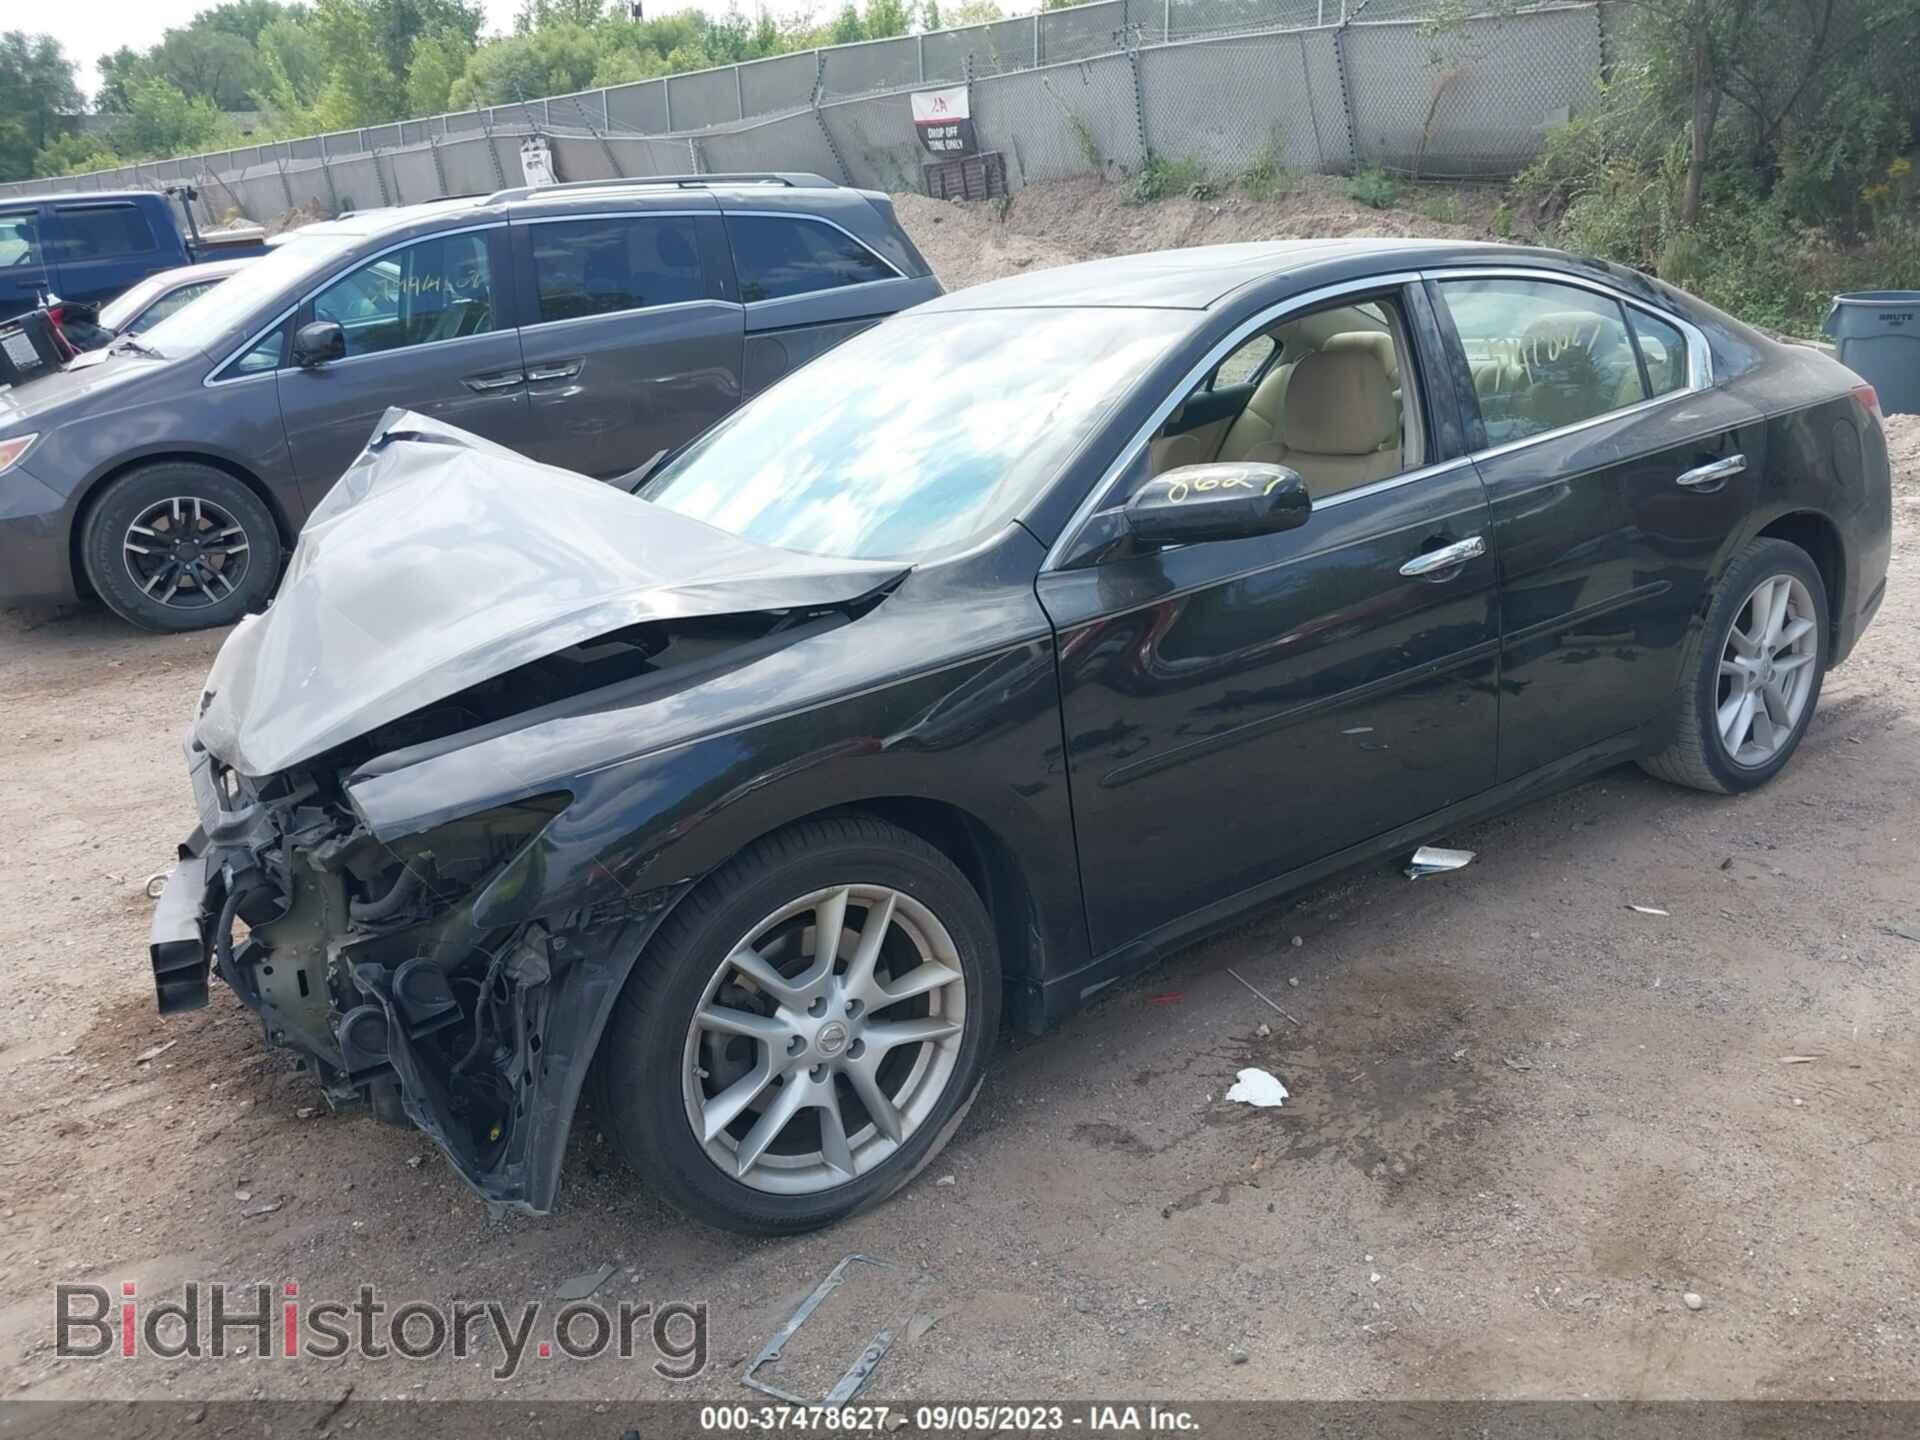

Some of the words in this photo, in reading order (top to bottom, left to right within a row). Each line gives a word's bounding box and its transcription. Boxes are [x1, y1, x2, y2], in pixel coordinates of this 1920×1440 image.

[928, 127, 945, 139] DROP
[945, 126, 958, 138] OFF
[928, 140, 946, 151] ZONE
[945, 139, 963, 150] ONLY
[1879, 313, 1913, 321] BRUTE
